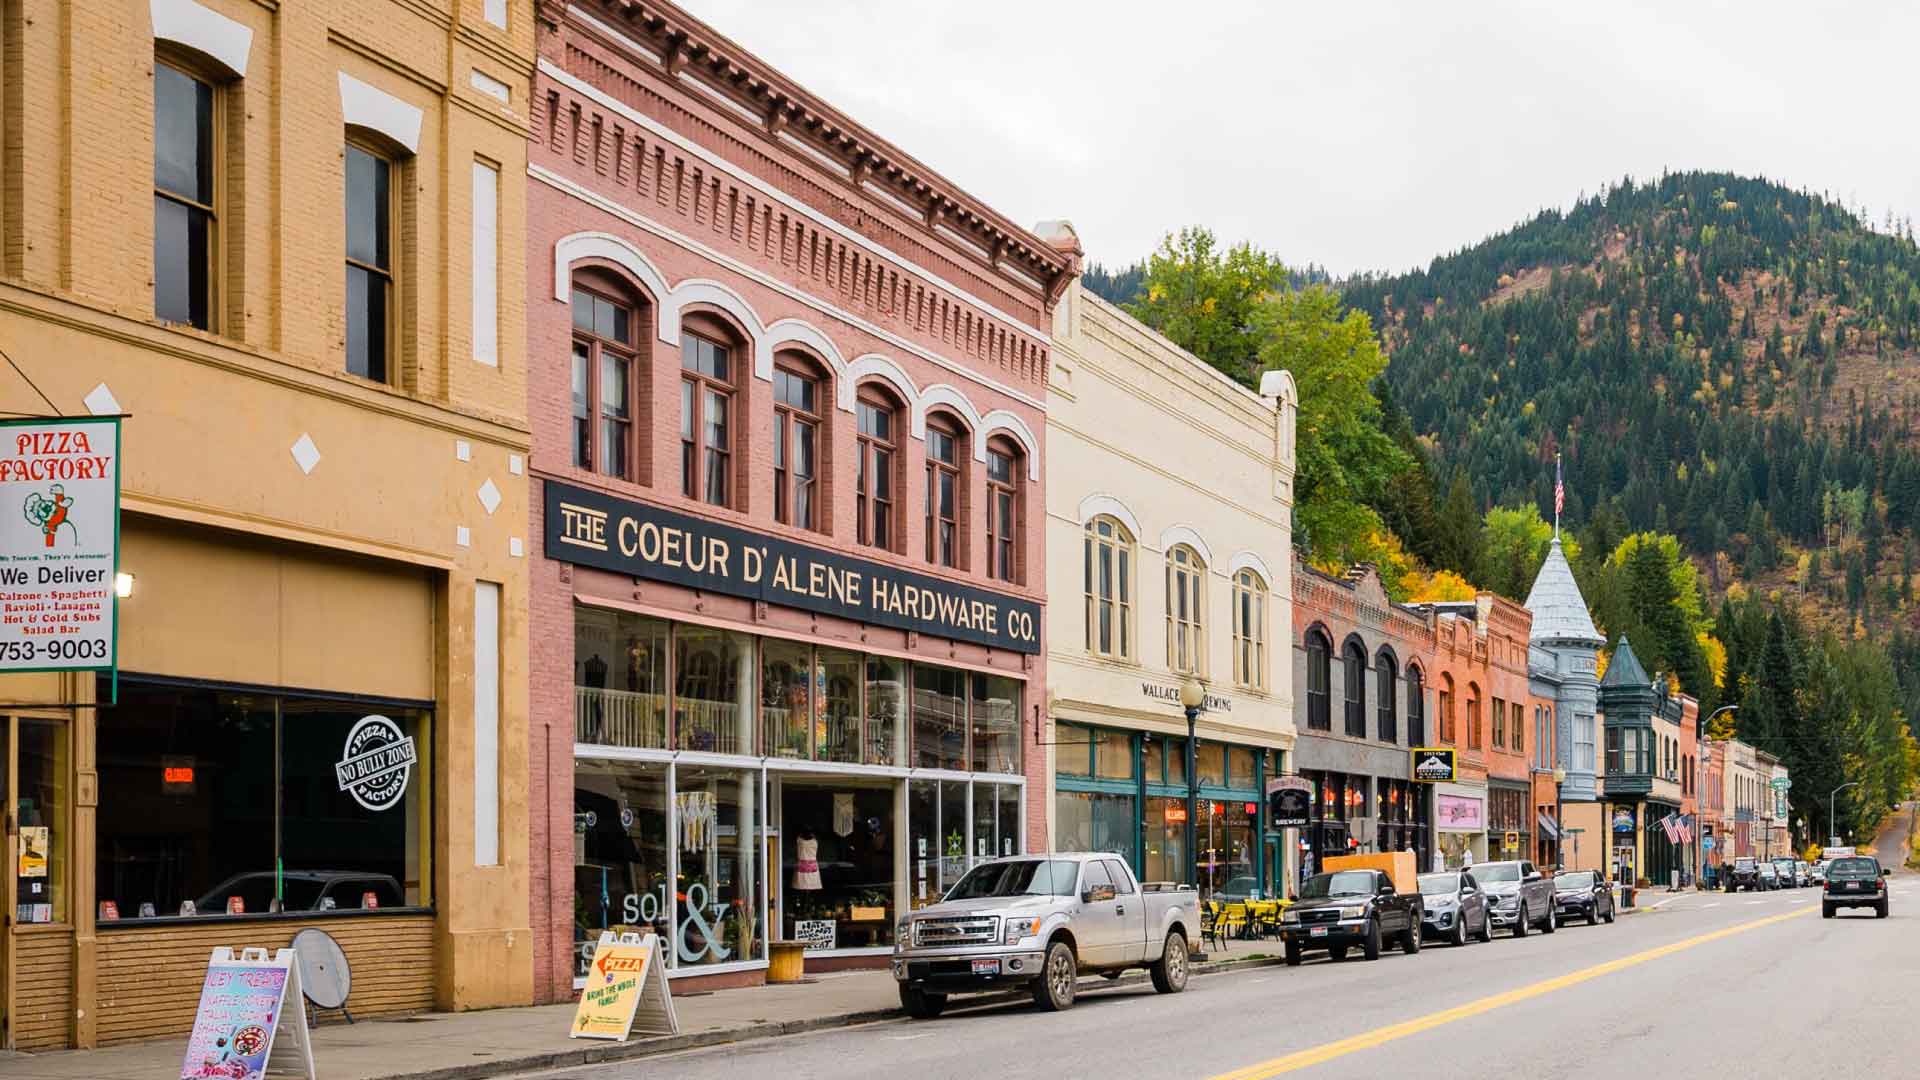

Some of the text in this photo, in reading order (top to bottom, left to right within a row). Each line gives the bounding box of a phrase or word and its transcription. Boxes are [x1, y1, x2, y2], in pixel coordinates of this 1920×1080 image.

[16, 432, 91, 455] PIZZA
[0, 457, 111, 481] FACTORY
[1, 566, 105, 585] We Deliver
[560, 509, 606, 544] THE
[618, 517, 729, 577] COEUR
[872, 577, 997, 634] HARDWARE
[1007, 609, 1035, 641] CO.
[0, 590, 107, 600] Calzone Spaghetti
[5, 602, 101, 612] Ravioli Lasagna
[4, 613, 101, 624] Hot & Cold Subs
[23, 625, 80, 634] Salad Bar
[0, 639, 106, 660] 753-9003
[1142, 683, 1231, 711] WALLACE REWING
[353, 725, 387, 748] PIZZA
[340, 744, 411, 783] NO BULLY ZONE
[358, 771, 404, 801] FACTORY
[677, 883, 730, 962] &
[604, 957, 641, 971] PIZZA
[606, 984, 617, 995] THE
